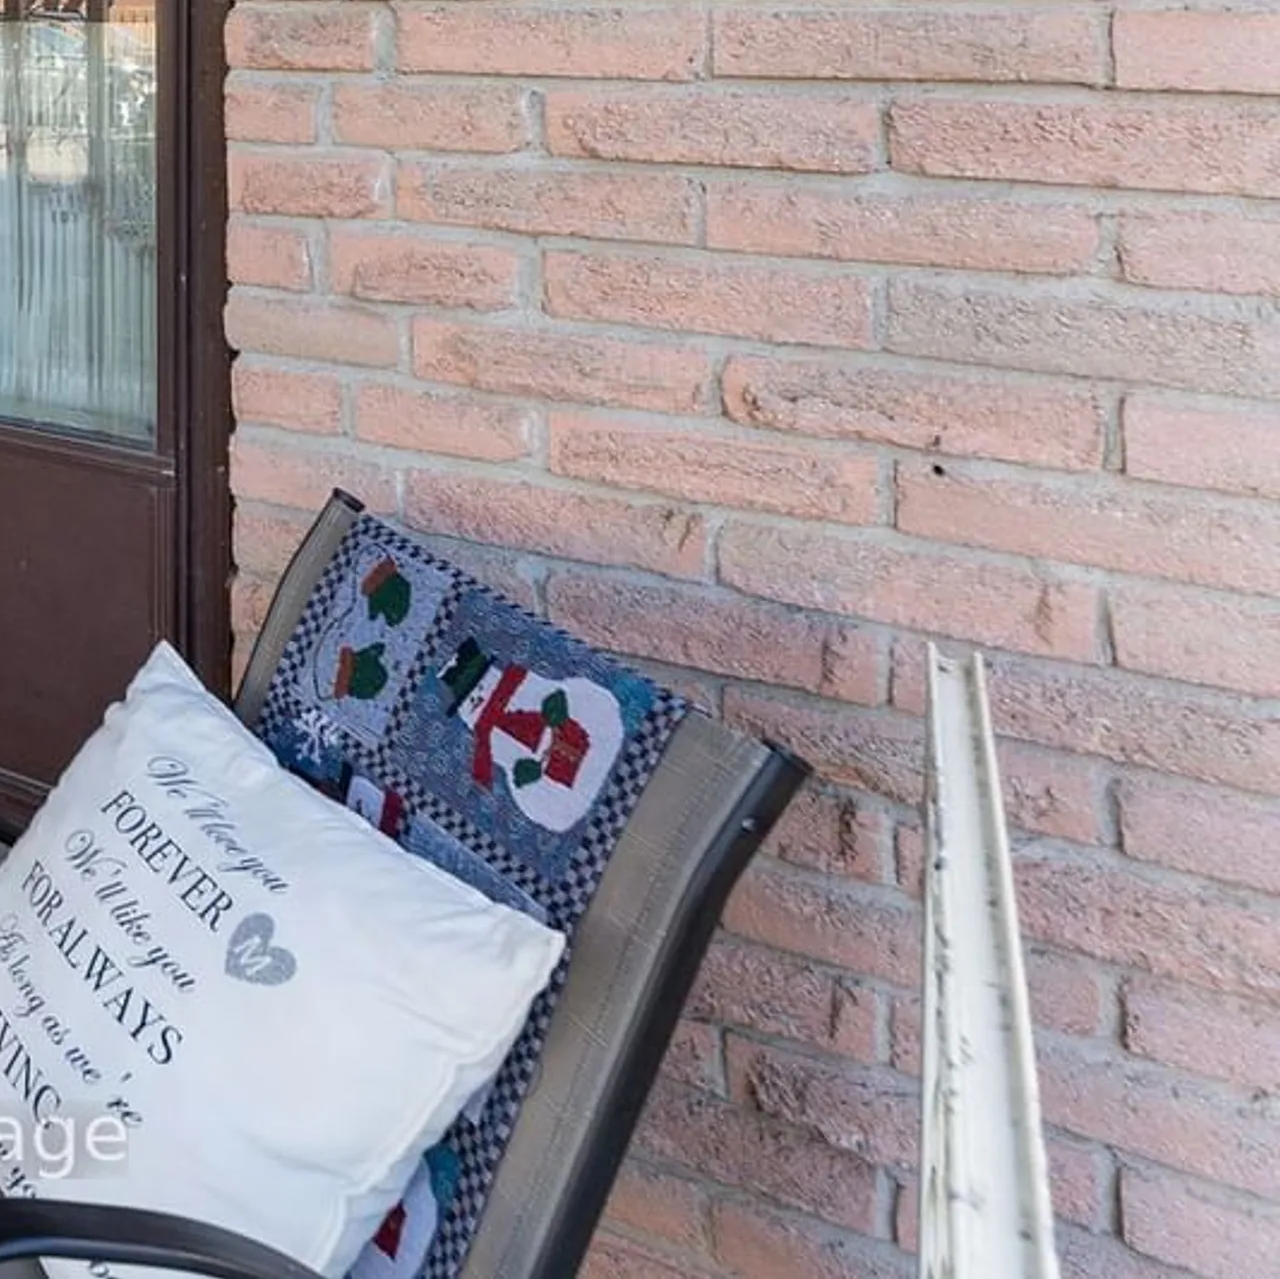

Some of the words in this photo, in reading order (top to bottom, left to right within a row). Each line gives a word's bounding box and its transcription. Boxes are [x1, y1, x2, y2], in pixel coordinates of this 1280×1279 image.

[100, 789, 234, 934] FOREVER
[200, 822, 247, 854] love
[217, 857, 290, 894] you
[110, 898, 152, 946] like
[21, 859, 65, 927] FOR
[48, 916, 183, 1066] ALWAYS
[127, 945, 196, 993] you
[7, 952, 46, 1019] long
[42, 1014, 72, 1047] as
